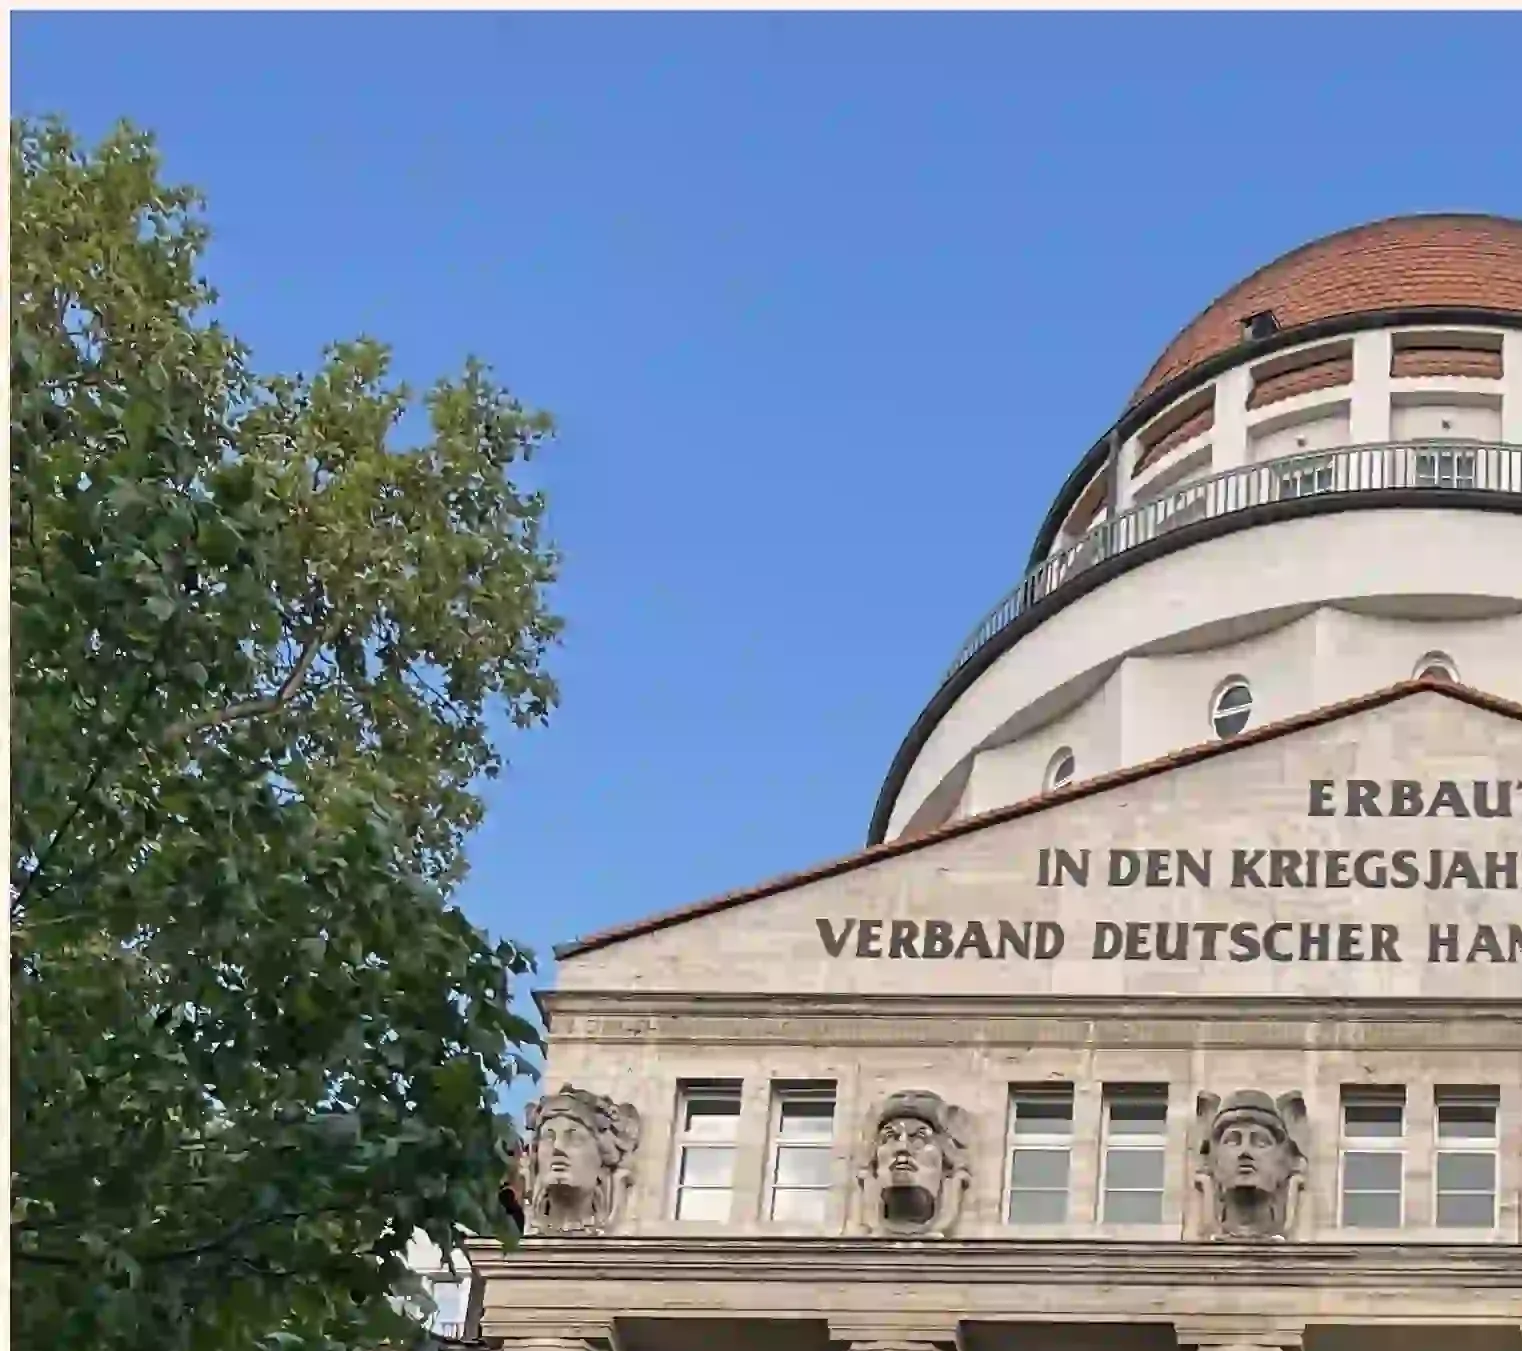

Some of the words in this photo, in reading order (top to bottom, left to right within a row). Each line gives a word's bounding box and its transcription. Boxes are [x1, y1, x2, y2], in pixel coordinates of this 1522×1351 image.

[1037, 848, 1089, 887] IN
[1107, 848, 1211, 888] DEN
[815, 917, 1066, 960] VERBAND
[1092, 920, 1402, 964] DEUTSCHER
